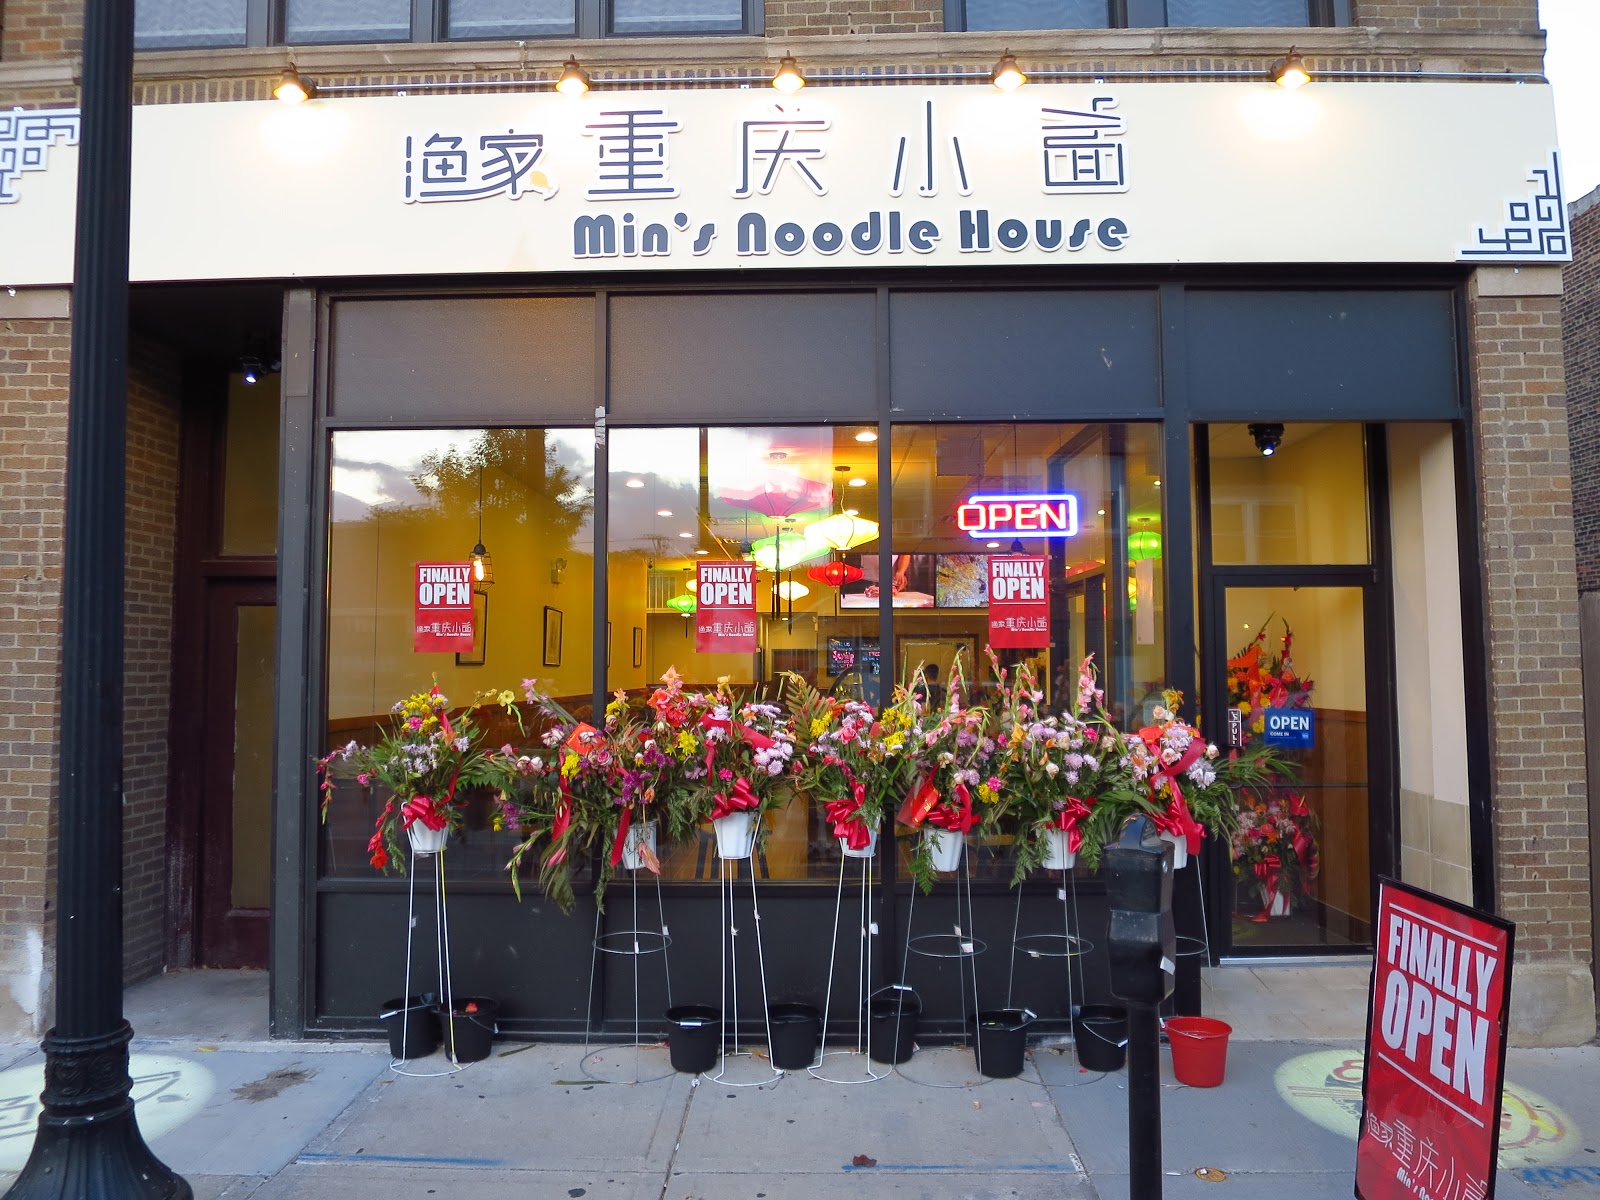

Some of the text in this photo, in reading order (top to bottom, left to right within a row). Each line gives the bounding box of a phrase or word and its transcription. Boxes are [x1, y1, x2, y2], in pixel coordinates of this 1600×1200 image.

[573, 209, 1128, 254] Min's Noodle House
[957, 503, 1067, 531] OPEN
[419, 567, 471, 582] FINALLY
[700, 567, 752, 582] FINALLY
[992, 562, 1044, 577] FINALLY
[419, 583, 470, 605] OPEN
[700, 583, 753, 605] OPEN
[992, 578, 1045, 600] OPEN
[1269, 716, 1310, 730] OPEN
[1387, 913, 1497, 1013] FINALLY
[1381, 969, 1490, 1106] OPEN
[1396, 1166, 1419, 1194] Min's
